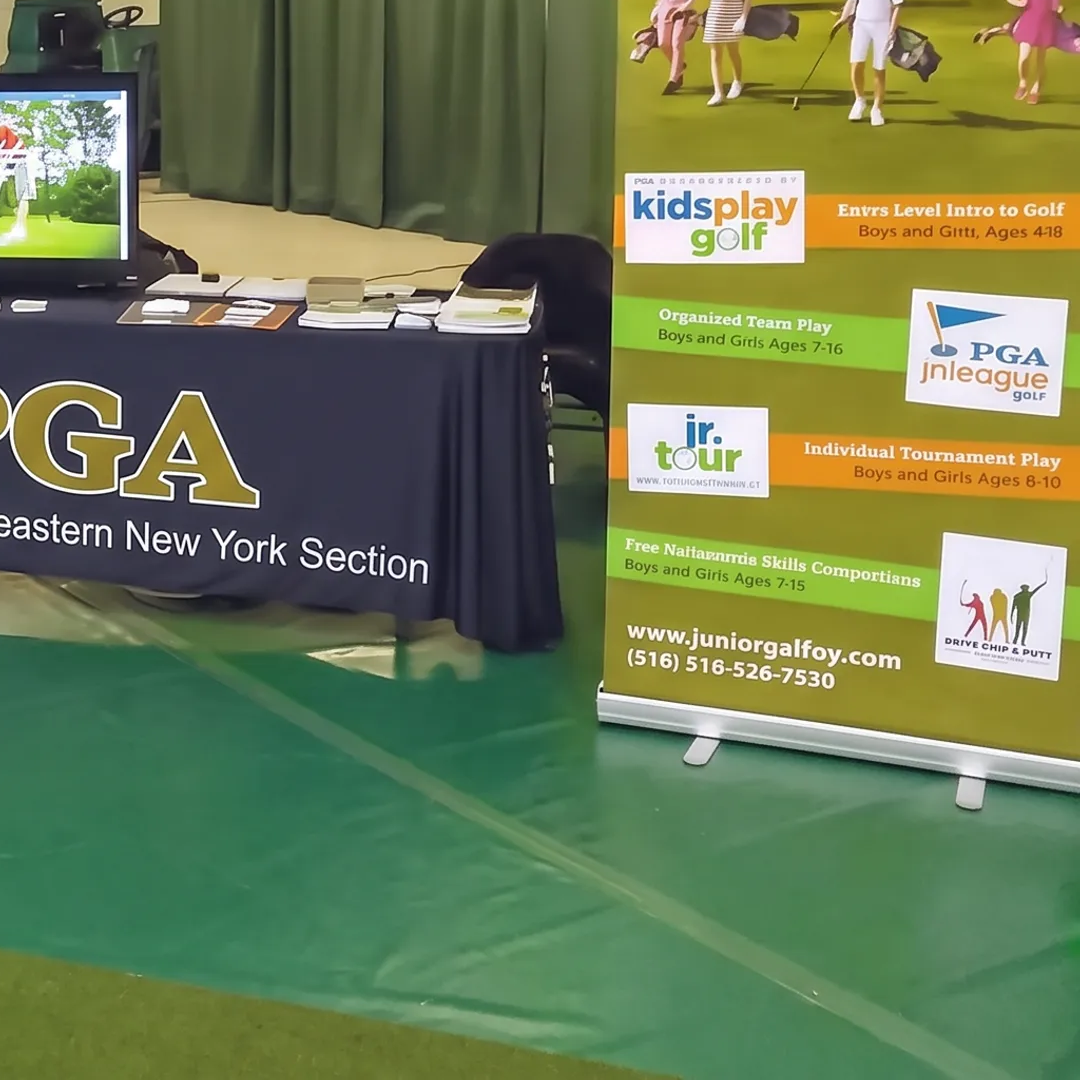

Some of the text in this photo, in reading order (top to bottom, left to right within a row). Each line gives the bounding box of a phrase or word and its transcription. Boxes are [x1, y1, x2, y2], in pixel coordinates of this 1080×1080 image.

[632, 190, 799, 226] kidsplay
[893, 202, 941, 217] Level
[946, 203, 995, 217] Intro
[999, 204, 1019, 217] to
[1023, 202, 1066, 217] Golf
[690, 221, 768, 257] golf
[858, 224, 898, 240] Boys
[902, 224, 933, 238] and
[985, 225, 1028, 241] Ages
[658, 308, 833, 336] Organized Team Play
[658, 328, 693, 345] Boys
[696, 333, 726, 346] and
[768, 337, 808, 354] Ages
[812, 340, 844, 355] 7-16
[970, 342, 1050, 368] PGA
[654, 441, 743, 472] tour
[804, 441, 1062, 472] Individual Tournament Play
[854, 465, 1062, 490] Boys and Girls Ages 8-10
[123, 521, 202, 559] New
[211, 528, 288, 567] York
[298, 538, 431, 585] Section
[625, 538, 660, 554] Free
[762, 554, 807, 572] Skills
[625, 557, 659, 575] Boys
[662, 564, 690, 578] and
[733, 573, 772, 589] Ages
[776, 576, 806, 593] 7-15
[627, 624, 902, 670] www.juniorgalfoy.com
[944, 637, 979, 649] DRIVE
[981, 642, 1010, 653] CHIP
[1011, 647, 1020, 655] &
[1022, 648, 1053, 660] PUTT
[627, 648, 836, 690] (516) 516-526-7530
